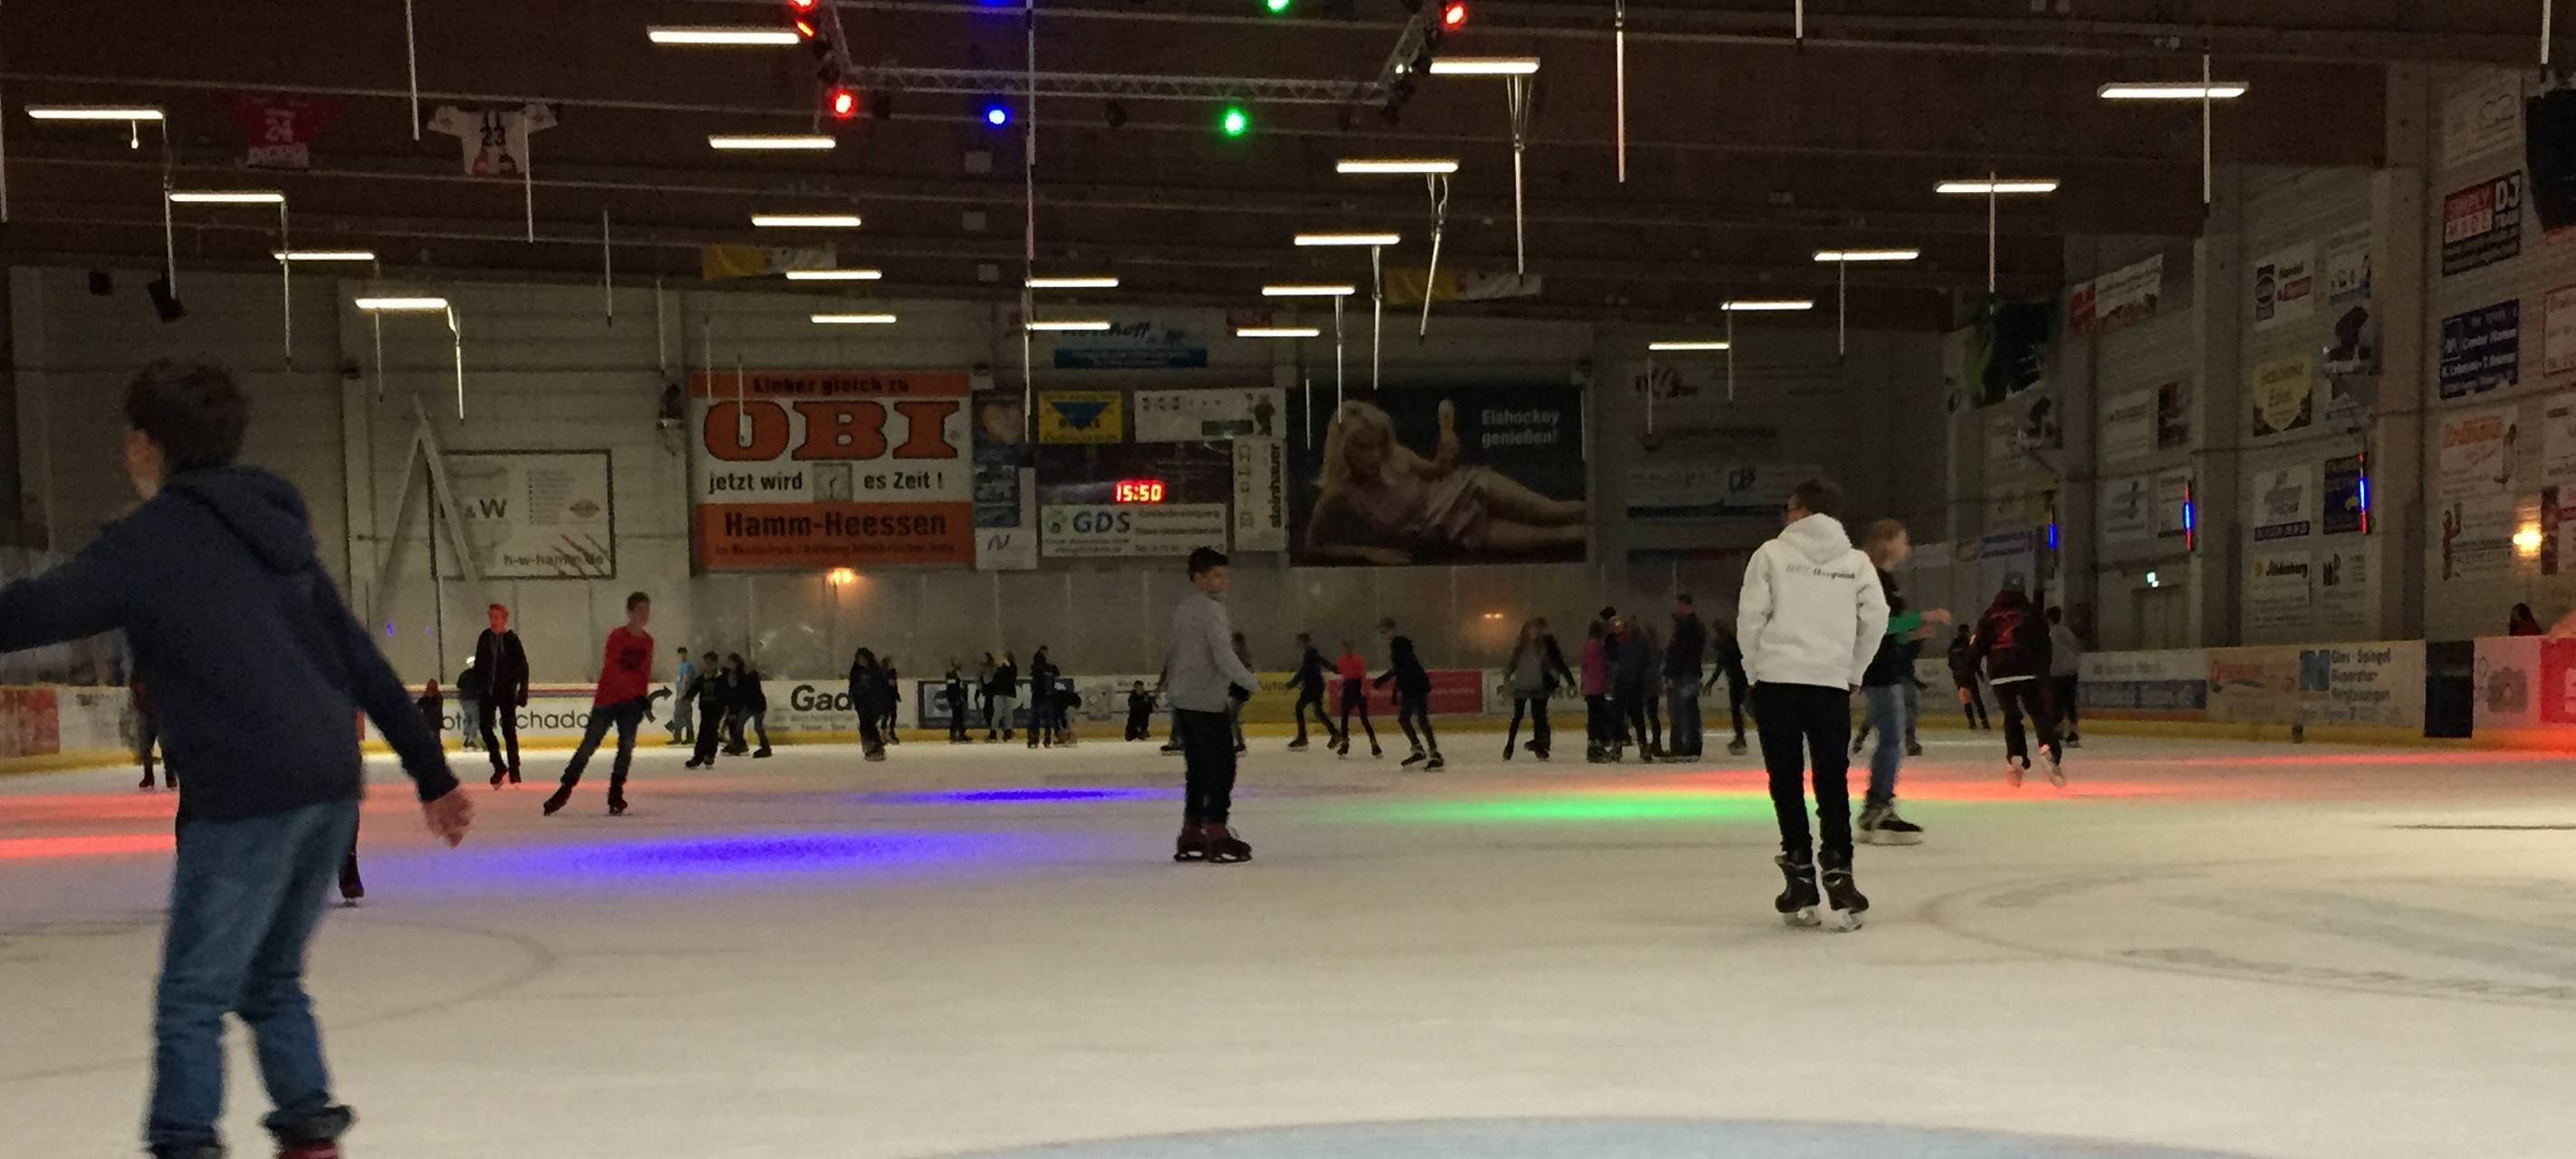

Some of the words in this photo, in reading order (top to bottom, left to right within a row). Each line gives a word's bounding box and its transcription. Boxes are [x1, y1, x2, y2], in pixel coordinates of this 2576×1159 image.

[480, 125, 506, 147] 23
[753, 377, 815, 393] Lieber
[821, 377, 882, 396] gleich
[1481, 407, 1560, 426] Eishockey
[704, 400, 959, 461] OBI
[707, 472, 755, 495] jetzt
[760, 472, 803, 492] wird
[863, 475, 887, 490] es
[893, 472, 931, 490] Zeit
[1115, 484, 1163, 503] 15:50
[725, 512, 947, 538] Hamm-Heessen
[1072, 511, 1130, 533] GDS
